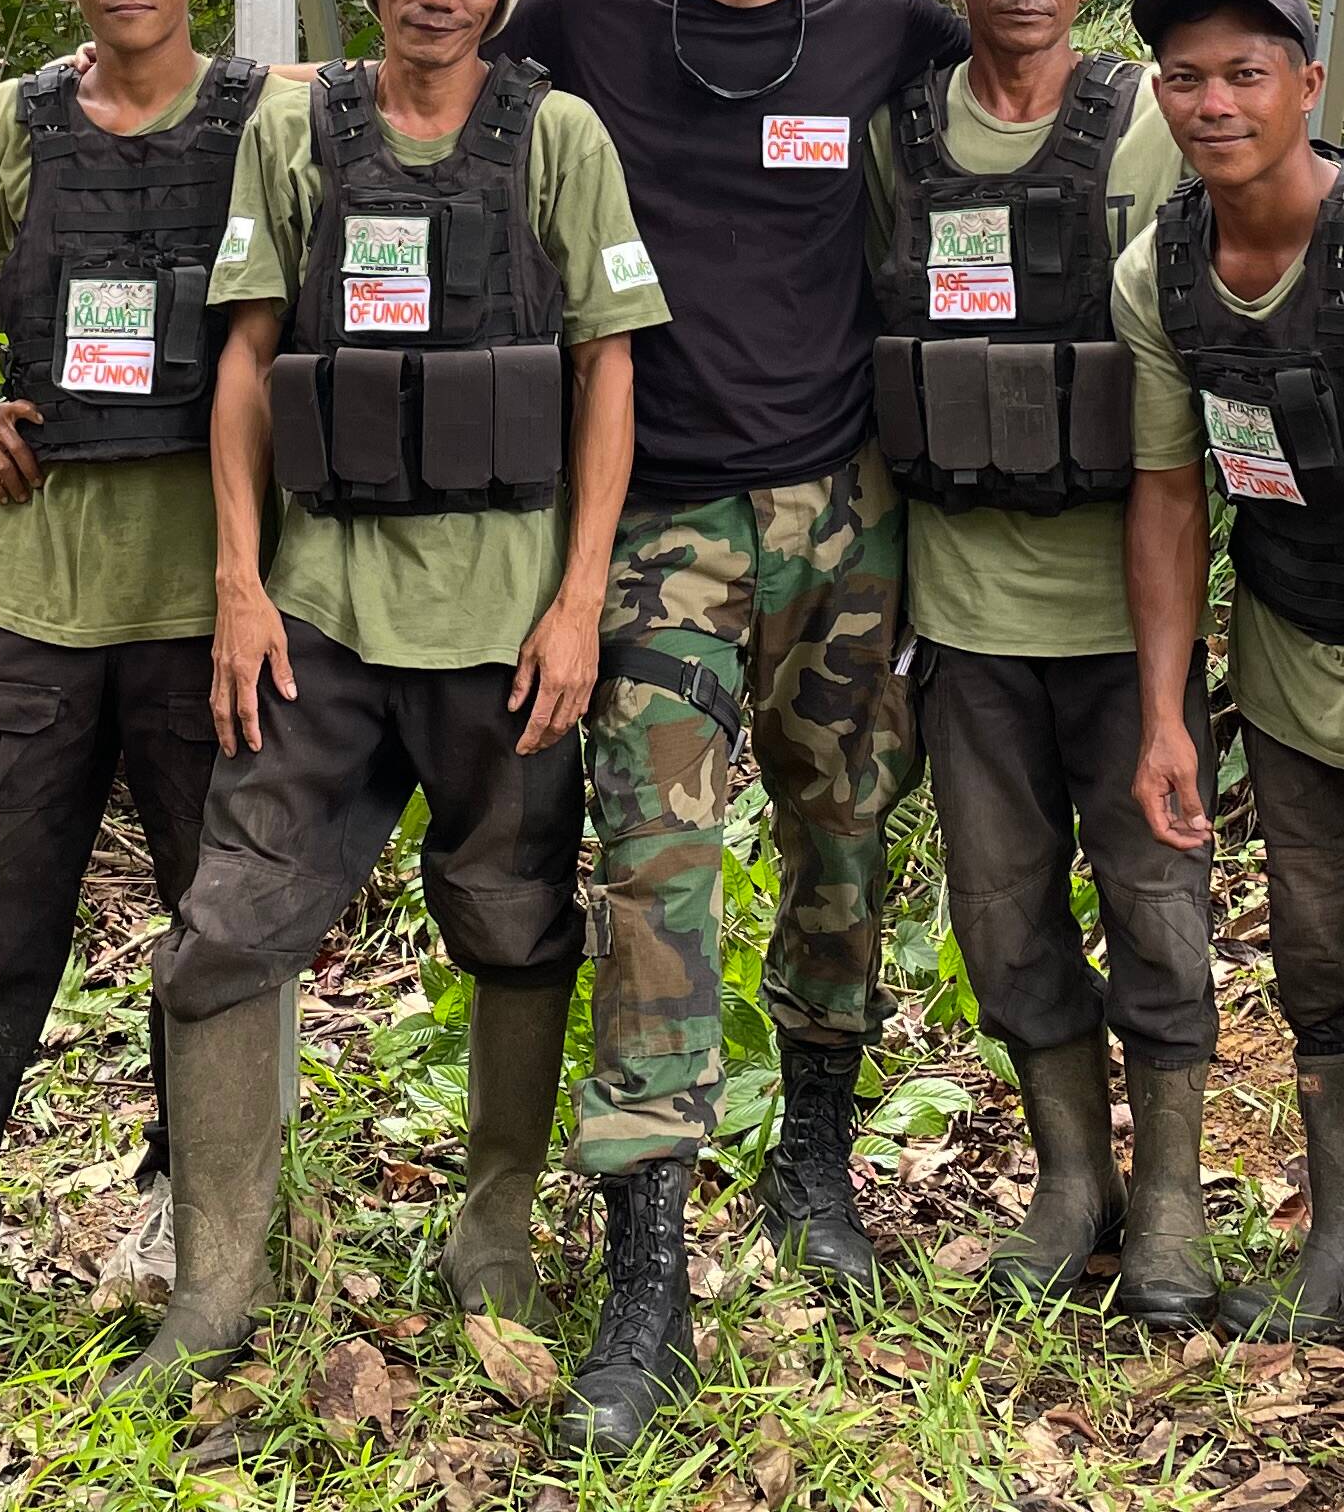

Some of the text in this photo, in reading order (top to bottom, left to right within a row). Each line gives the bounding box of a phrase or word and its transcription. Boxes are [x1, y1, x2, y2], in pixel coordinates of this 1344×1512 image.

[768, 141, 845, 162] OF UNION
[351, 242, 424, 264] KALAWEIT
[935, 292, 1011, 312] OF UNION
[74, 306, 152, 327] KALAWEIT
[350, 302, 425, 324] OF UNION
[68, 365, 149, 386] OF UNION
[1228, 471, 1300, 500] OF UNION
